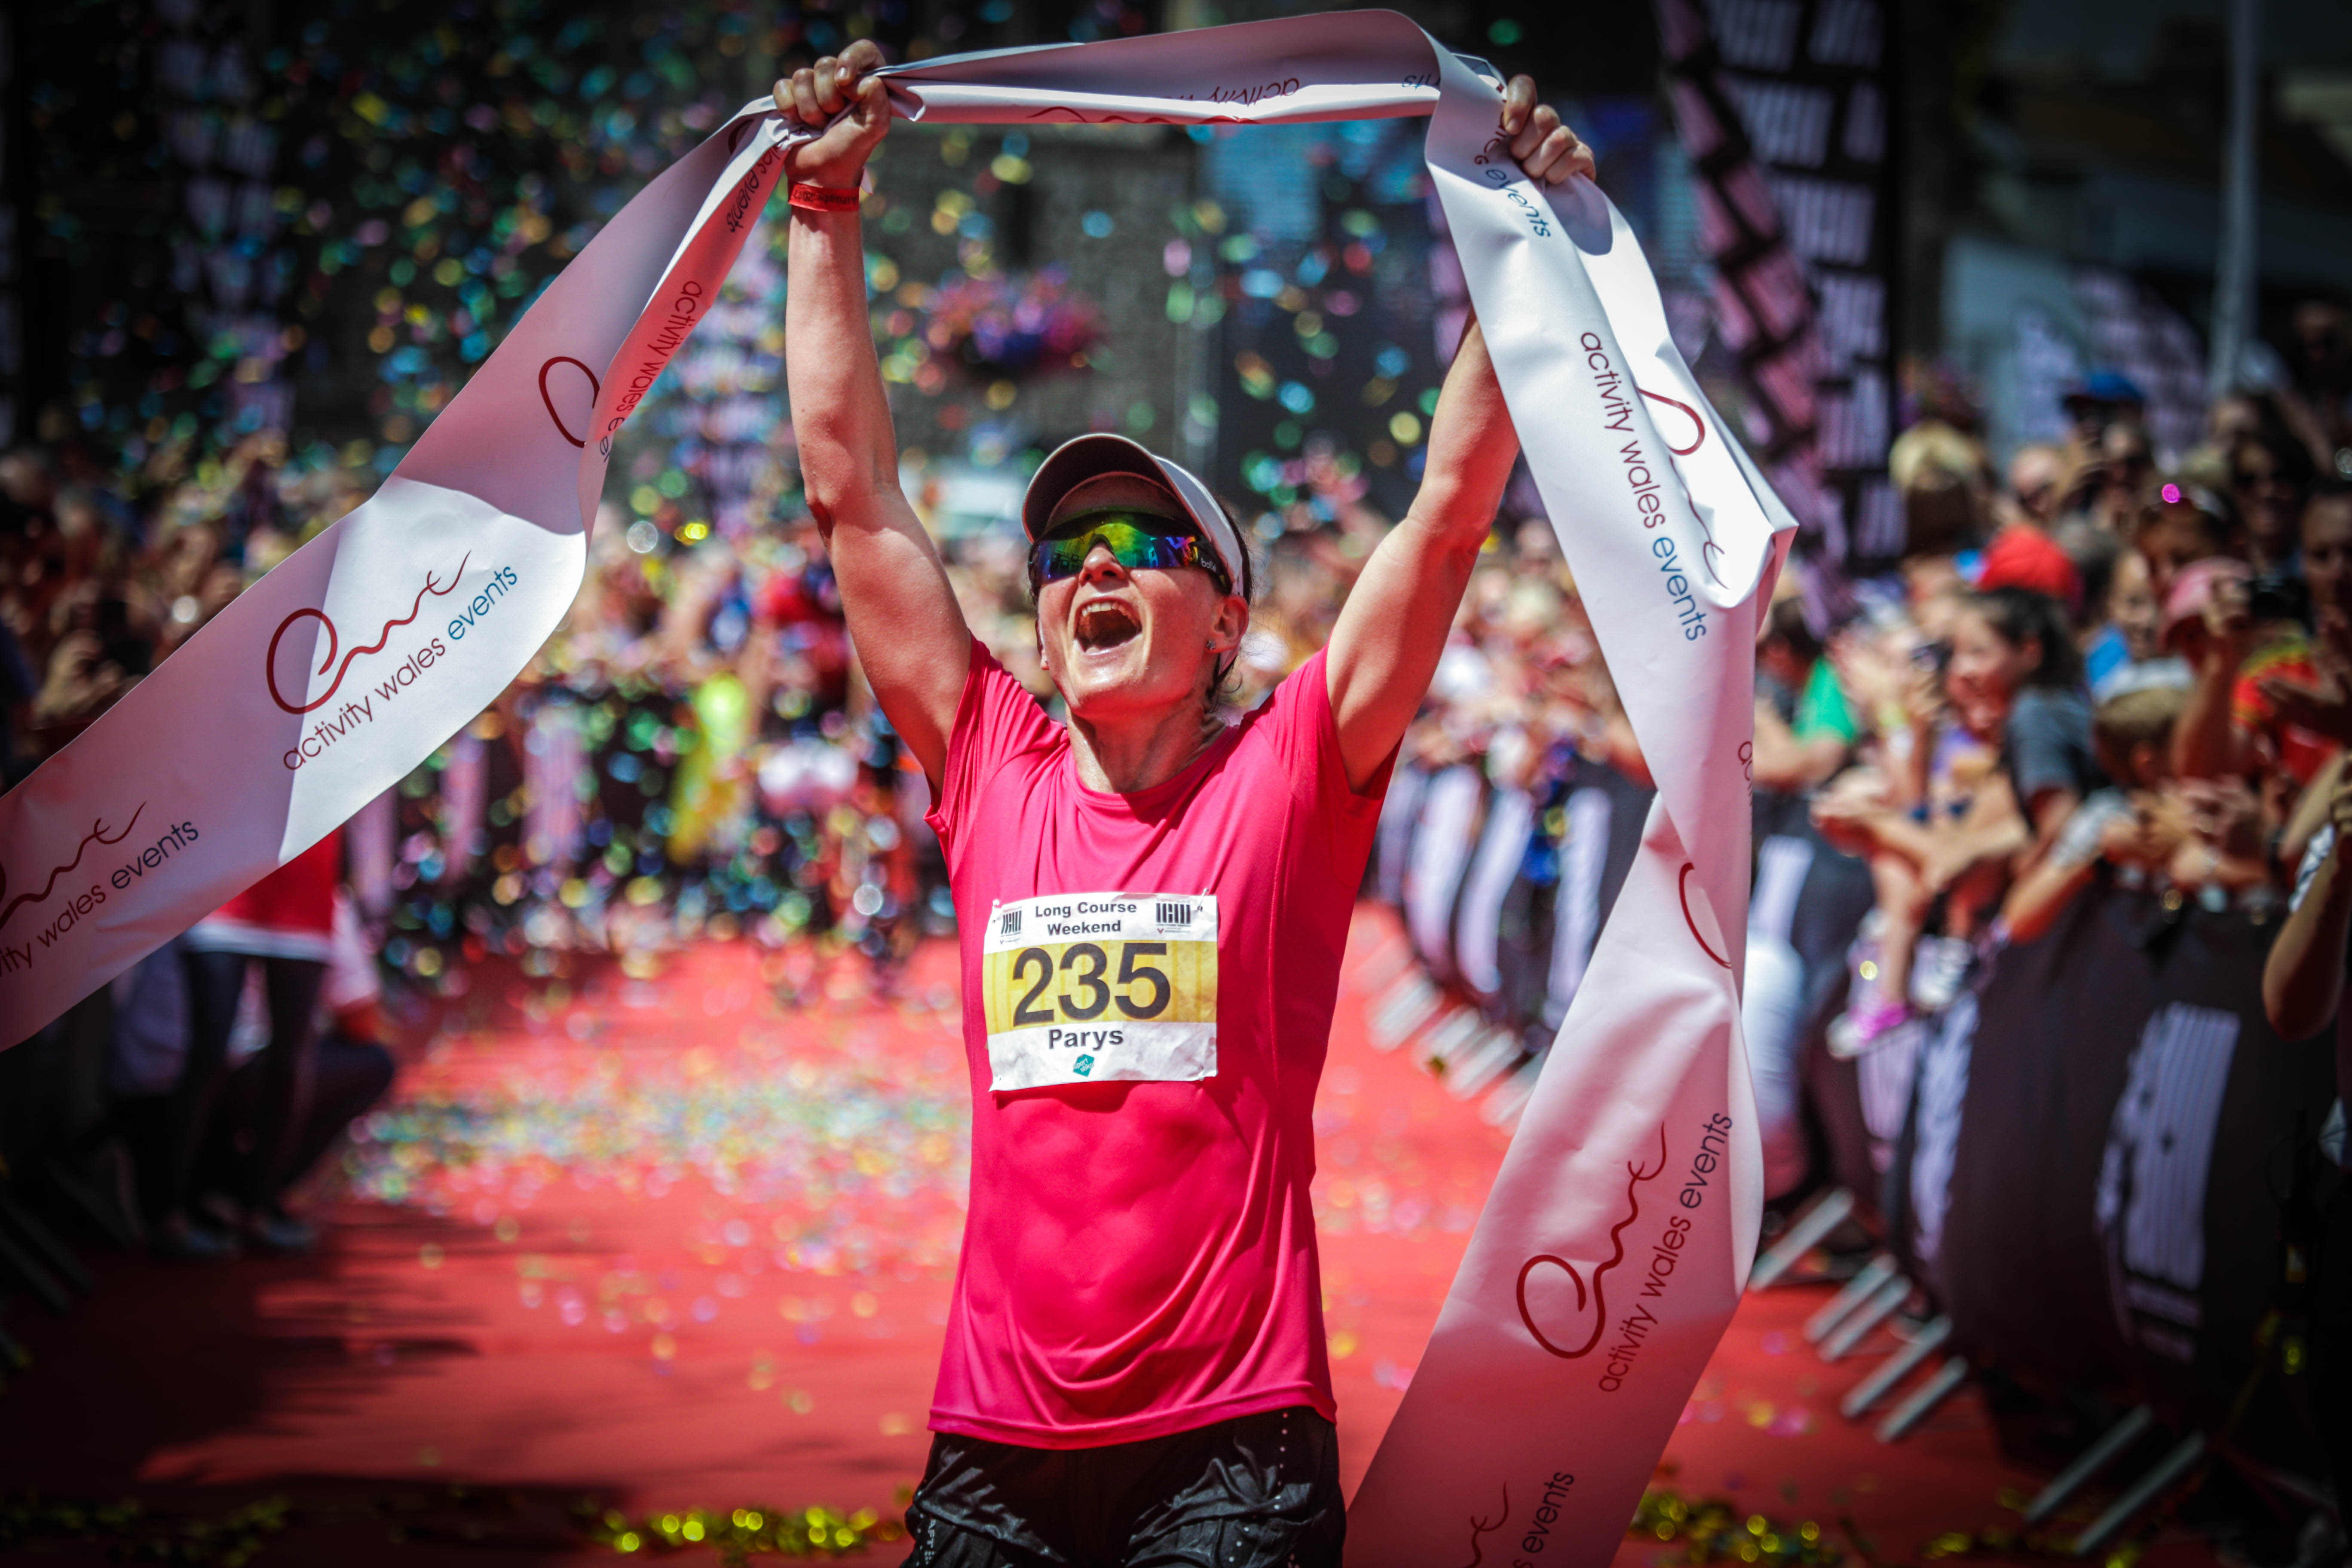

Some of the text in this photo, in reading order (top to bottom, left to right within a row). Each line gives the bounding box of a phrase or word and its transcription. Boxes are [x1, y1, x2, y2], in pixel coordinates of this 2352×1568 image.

[1208, 77, 1300, 107] activity
[1485, 168, 1551, 237] events
[616, 281, 702, 412] activity wales
[1580, 331, 1707, 641] activity wales events
[283, 566, 518, 771] activity wales events
[0, 821, 199, 977] ity wales events
[1035, 903, 1071, 919] Long
[1077, 902, 1138, 915] Course
[1047, 920, 1121, 936] Weekend
[1012, 942, 1171, 1027] 235
[1048, 1028, 1124, 1051] Parys
[1599, 1112, 1733, 1392] activity wales events
[1522, 1471, 1575, 1553] events
